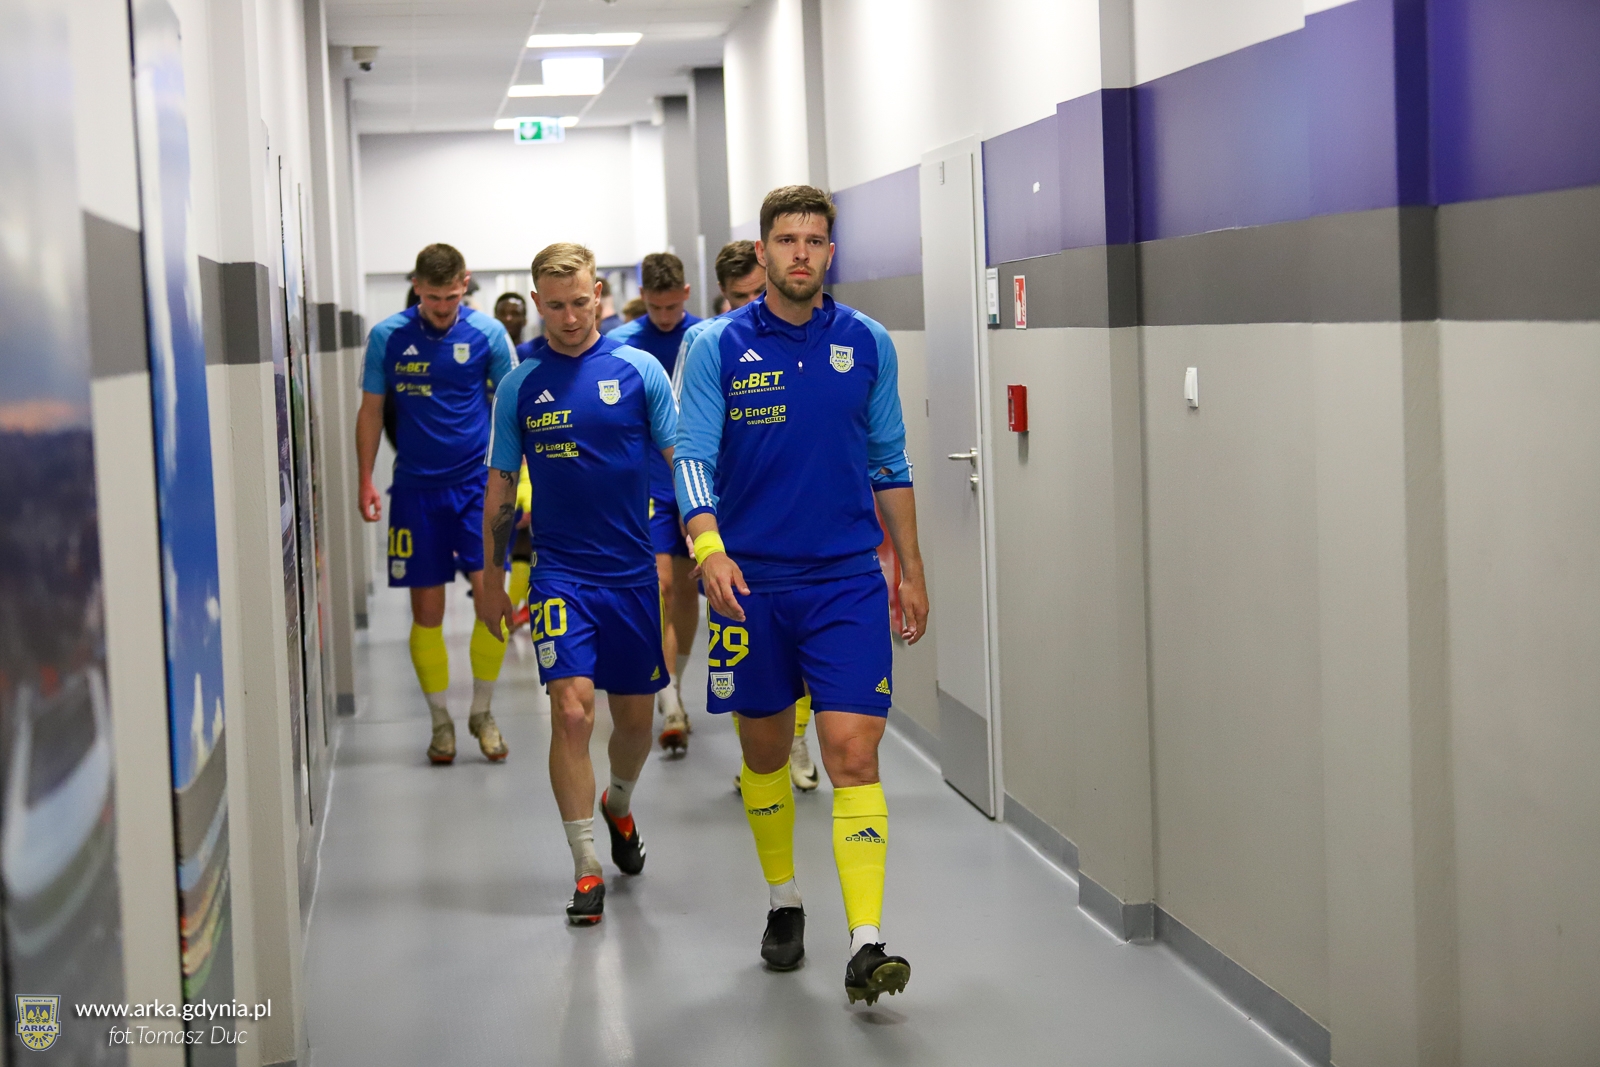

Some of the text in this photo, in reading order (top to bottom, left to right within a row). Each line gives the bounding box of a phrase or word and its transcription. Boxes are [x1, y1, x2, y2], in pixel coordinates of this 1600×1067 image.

[730, 371, 784, 390] orBET
[526, 410, 572, 429] forBET
[745, 405, 786, 418] Energa
[765, 416, 786, 424] ORLEN
[545, 442, 577, 452] Energa
[388, 528, 413, 558] 10
[530, 598, 567, 641] 20
[708, 623, 749, 667] 29
[845, 835, 885, 843] adidas
